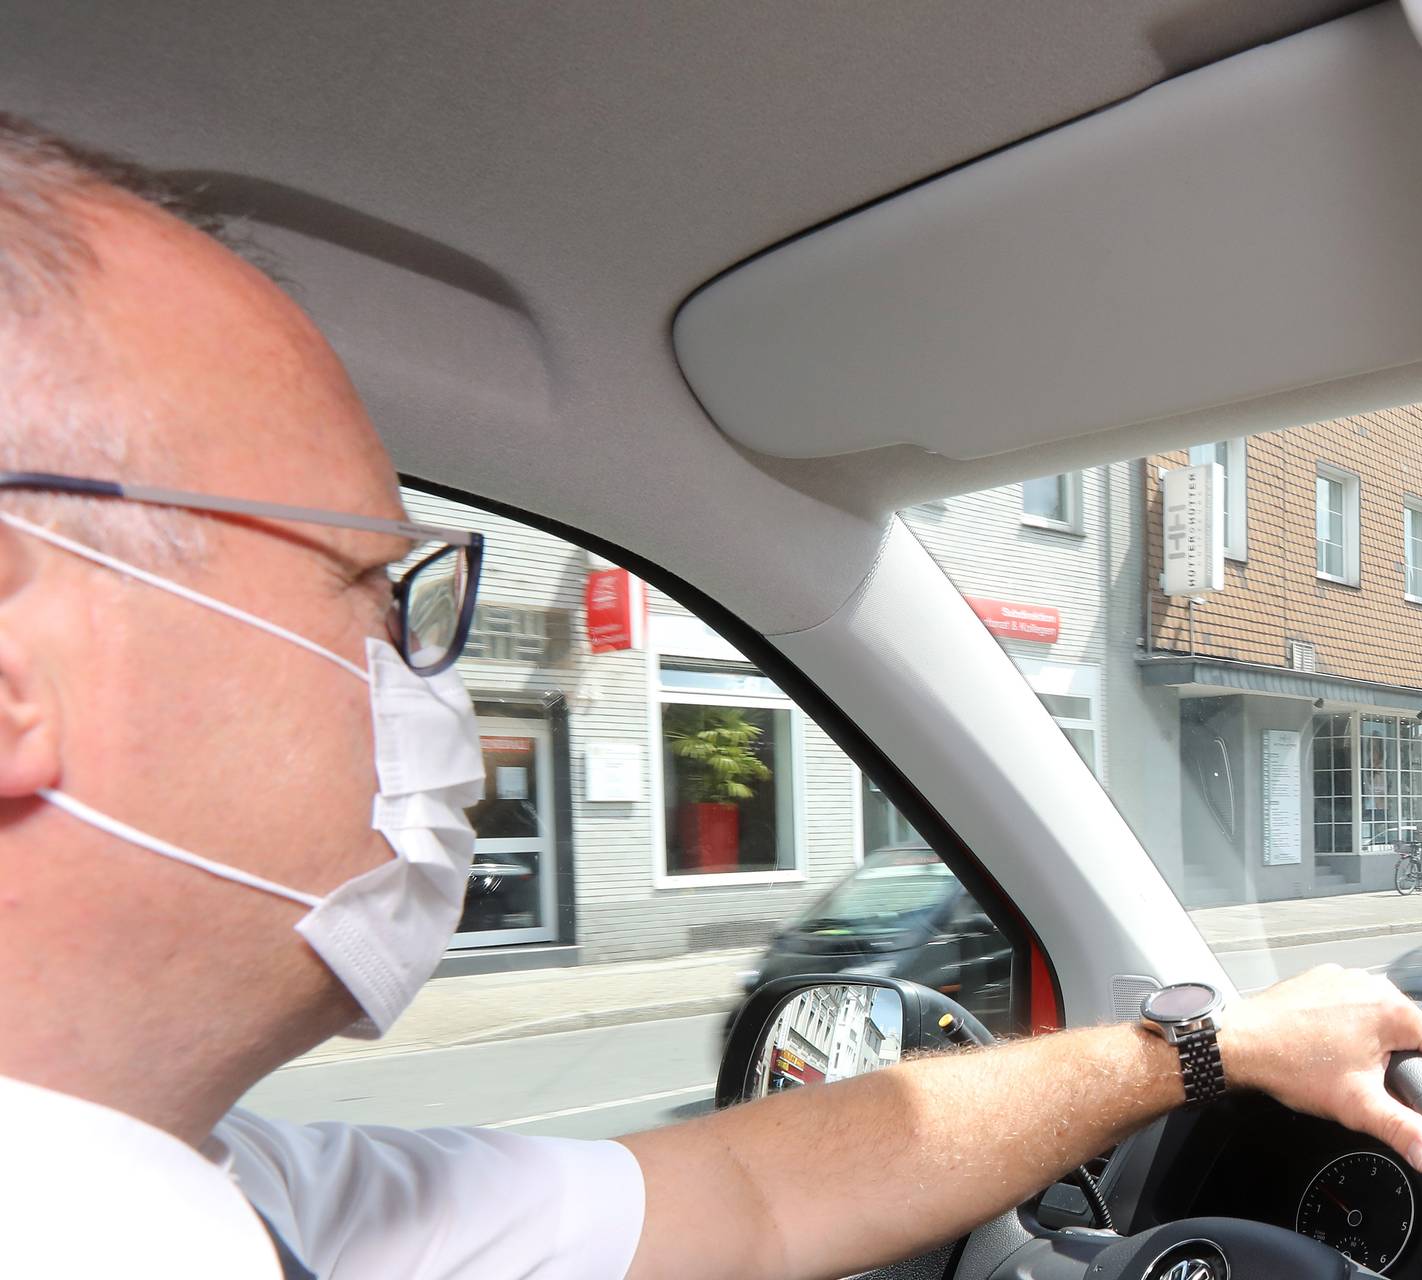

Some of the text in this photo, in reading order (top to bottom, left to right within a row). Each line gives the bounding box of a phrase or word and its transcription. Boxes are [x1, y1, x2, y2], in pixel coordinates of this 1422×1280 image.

[1370, 1167, 1377, 1176] 3
[1338, 1175, 1345, 1185] 2
[1395, 1186, 1402, 1195] 4
[1316, 1204, 1321, 1213] 1
[1401, 1221, 1408, 1231] 5
[1379, 1254, 1387, 1264] 6
